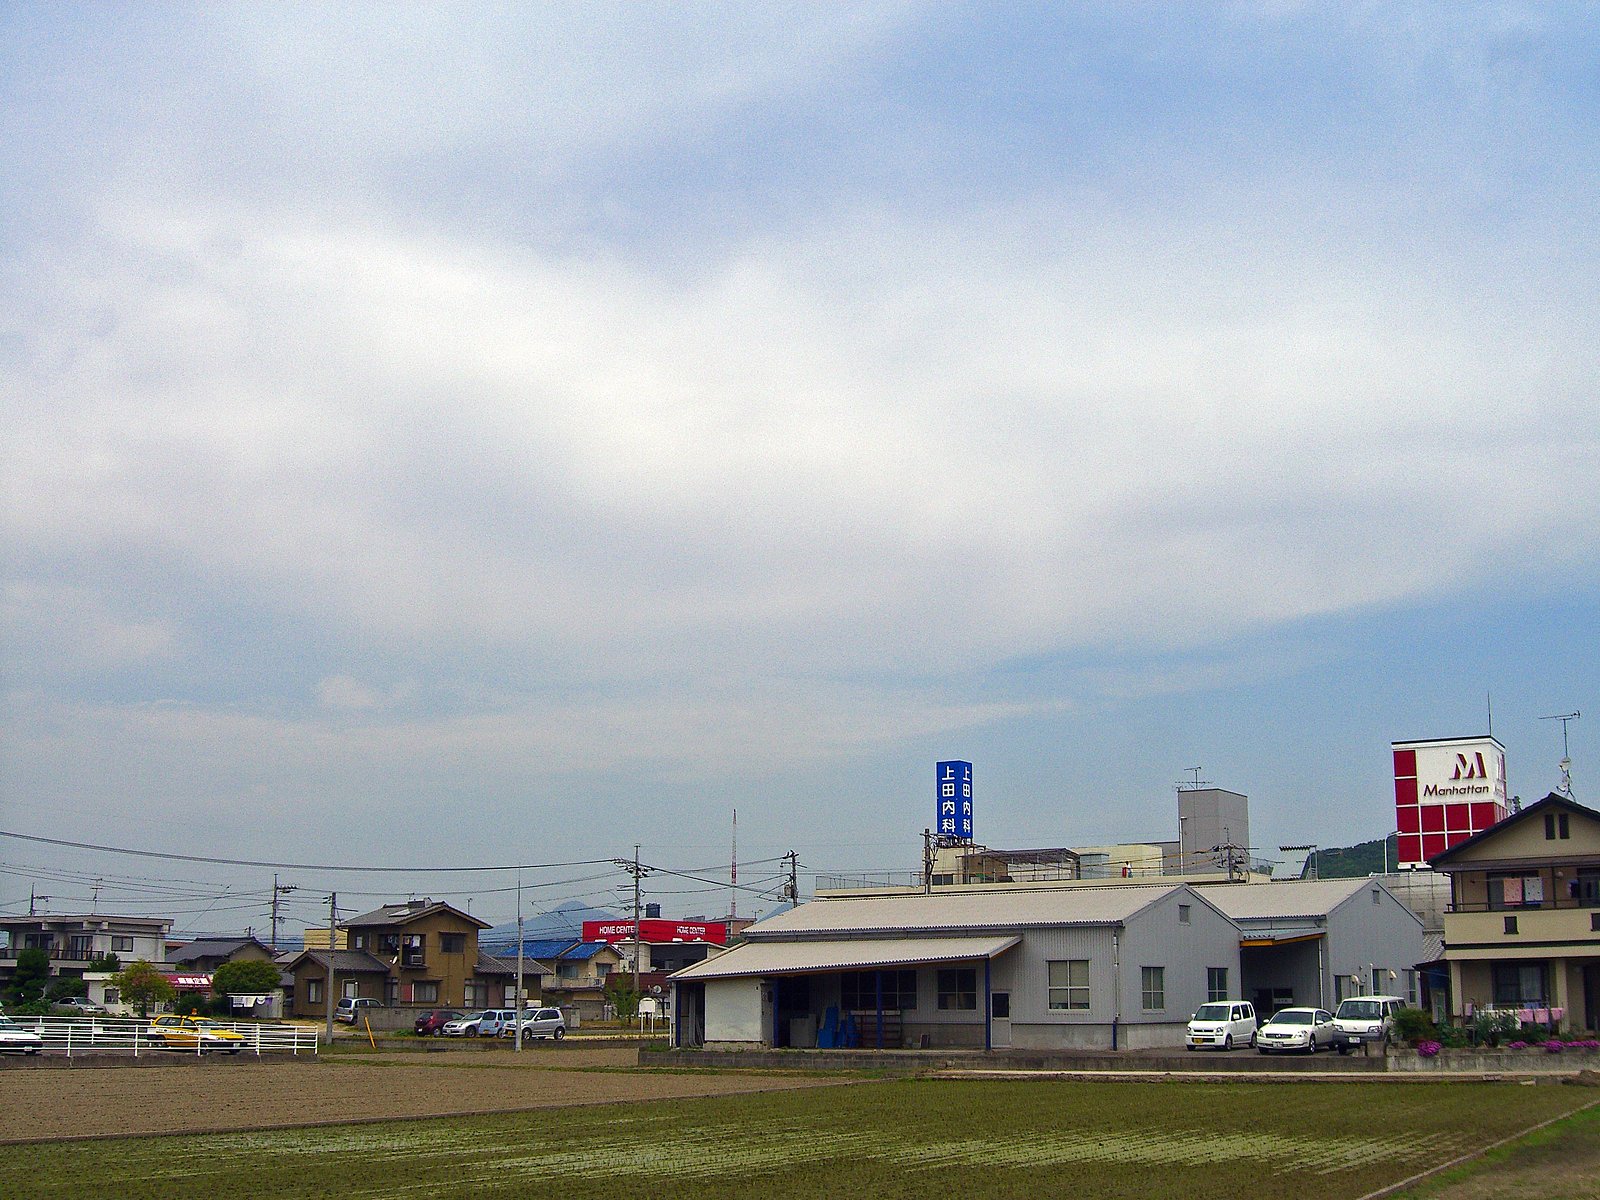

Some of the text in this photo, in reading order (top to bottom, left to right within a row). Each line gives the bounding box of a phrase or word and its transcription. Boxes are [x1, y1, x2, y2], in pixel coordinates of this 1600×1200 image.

[1423, 784, 1490, 797] Manhattan
[941, 765, 956, 833] 上田内科
[962, 766, 971, 834] 上田内科
[599, 925, 636, 935] HOME CENTE
[676, 925, 706, 936] HOME CENTER
